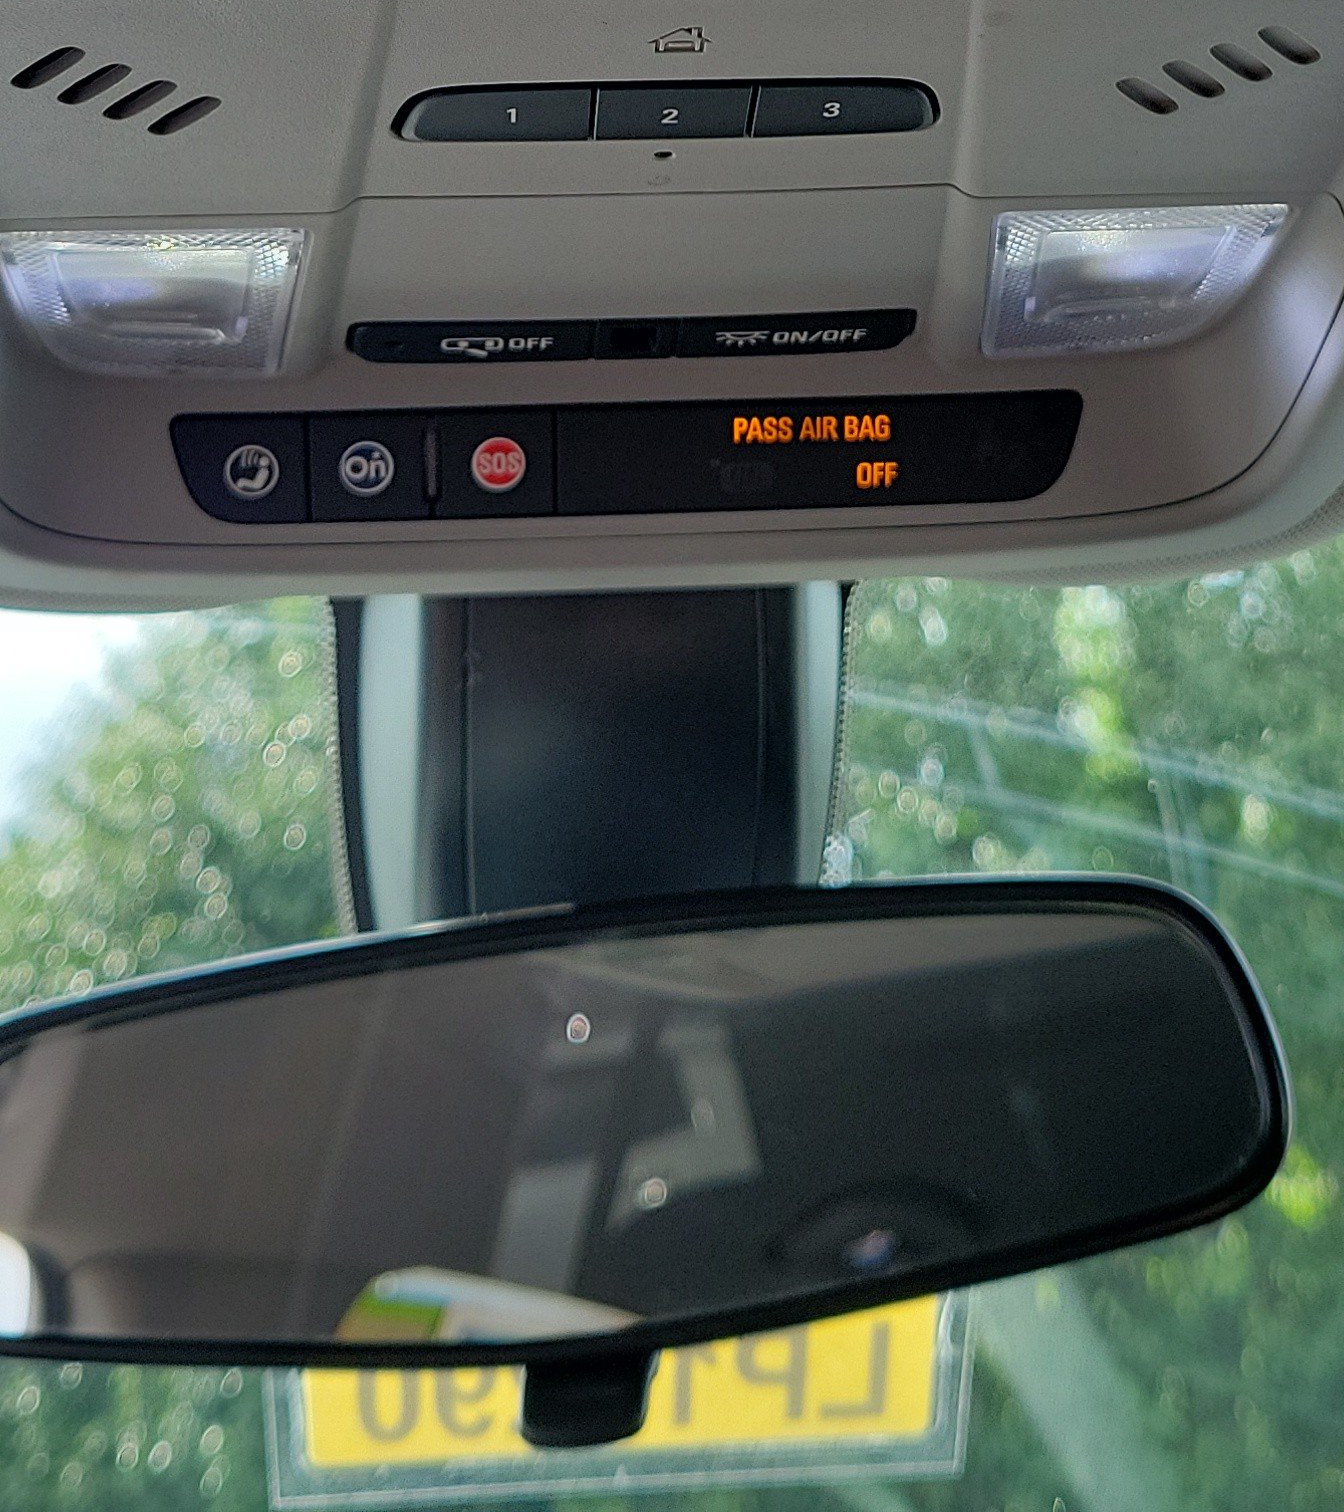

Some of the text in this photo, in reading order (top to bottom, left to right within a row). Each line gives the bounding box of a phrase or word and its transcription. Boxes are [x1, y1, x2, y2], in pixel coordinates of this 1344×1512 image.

[506, 107, 518, 124] 1
[660, 108, 680, 125] 2
[822, 102, 842, 118] 3
[507, 336, 554, 351] OFF
[771, 328, 868, 345] ON/OFF
[732, 413, 892, 445] PASS AIR BAG
[478, 451, 523, 475] SOS
[856, 460, 900, 490] OFF
